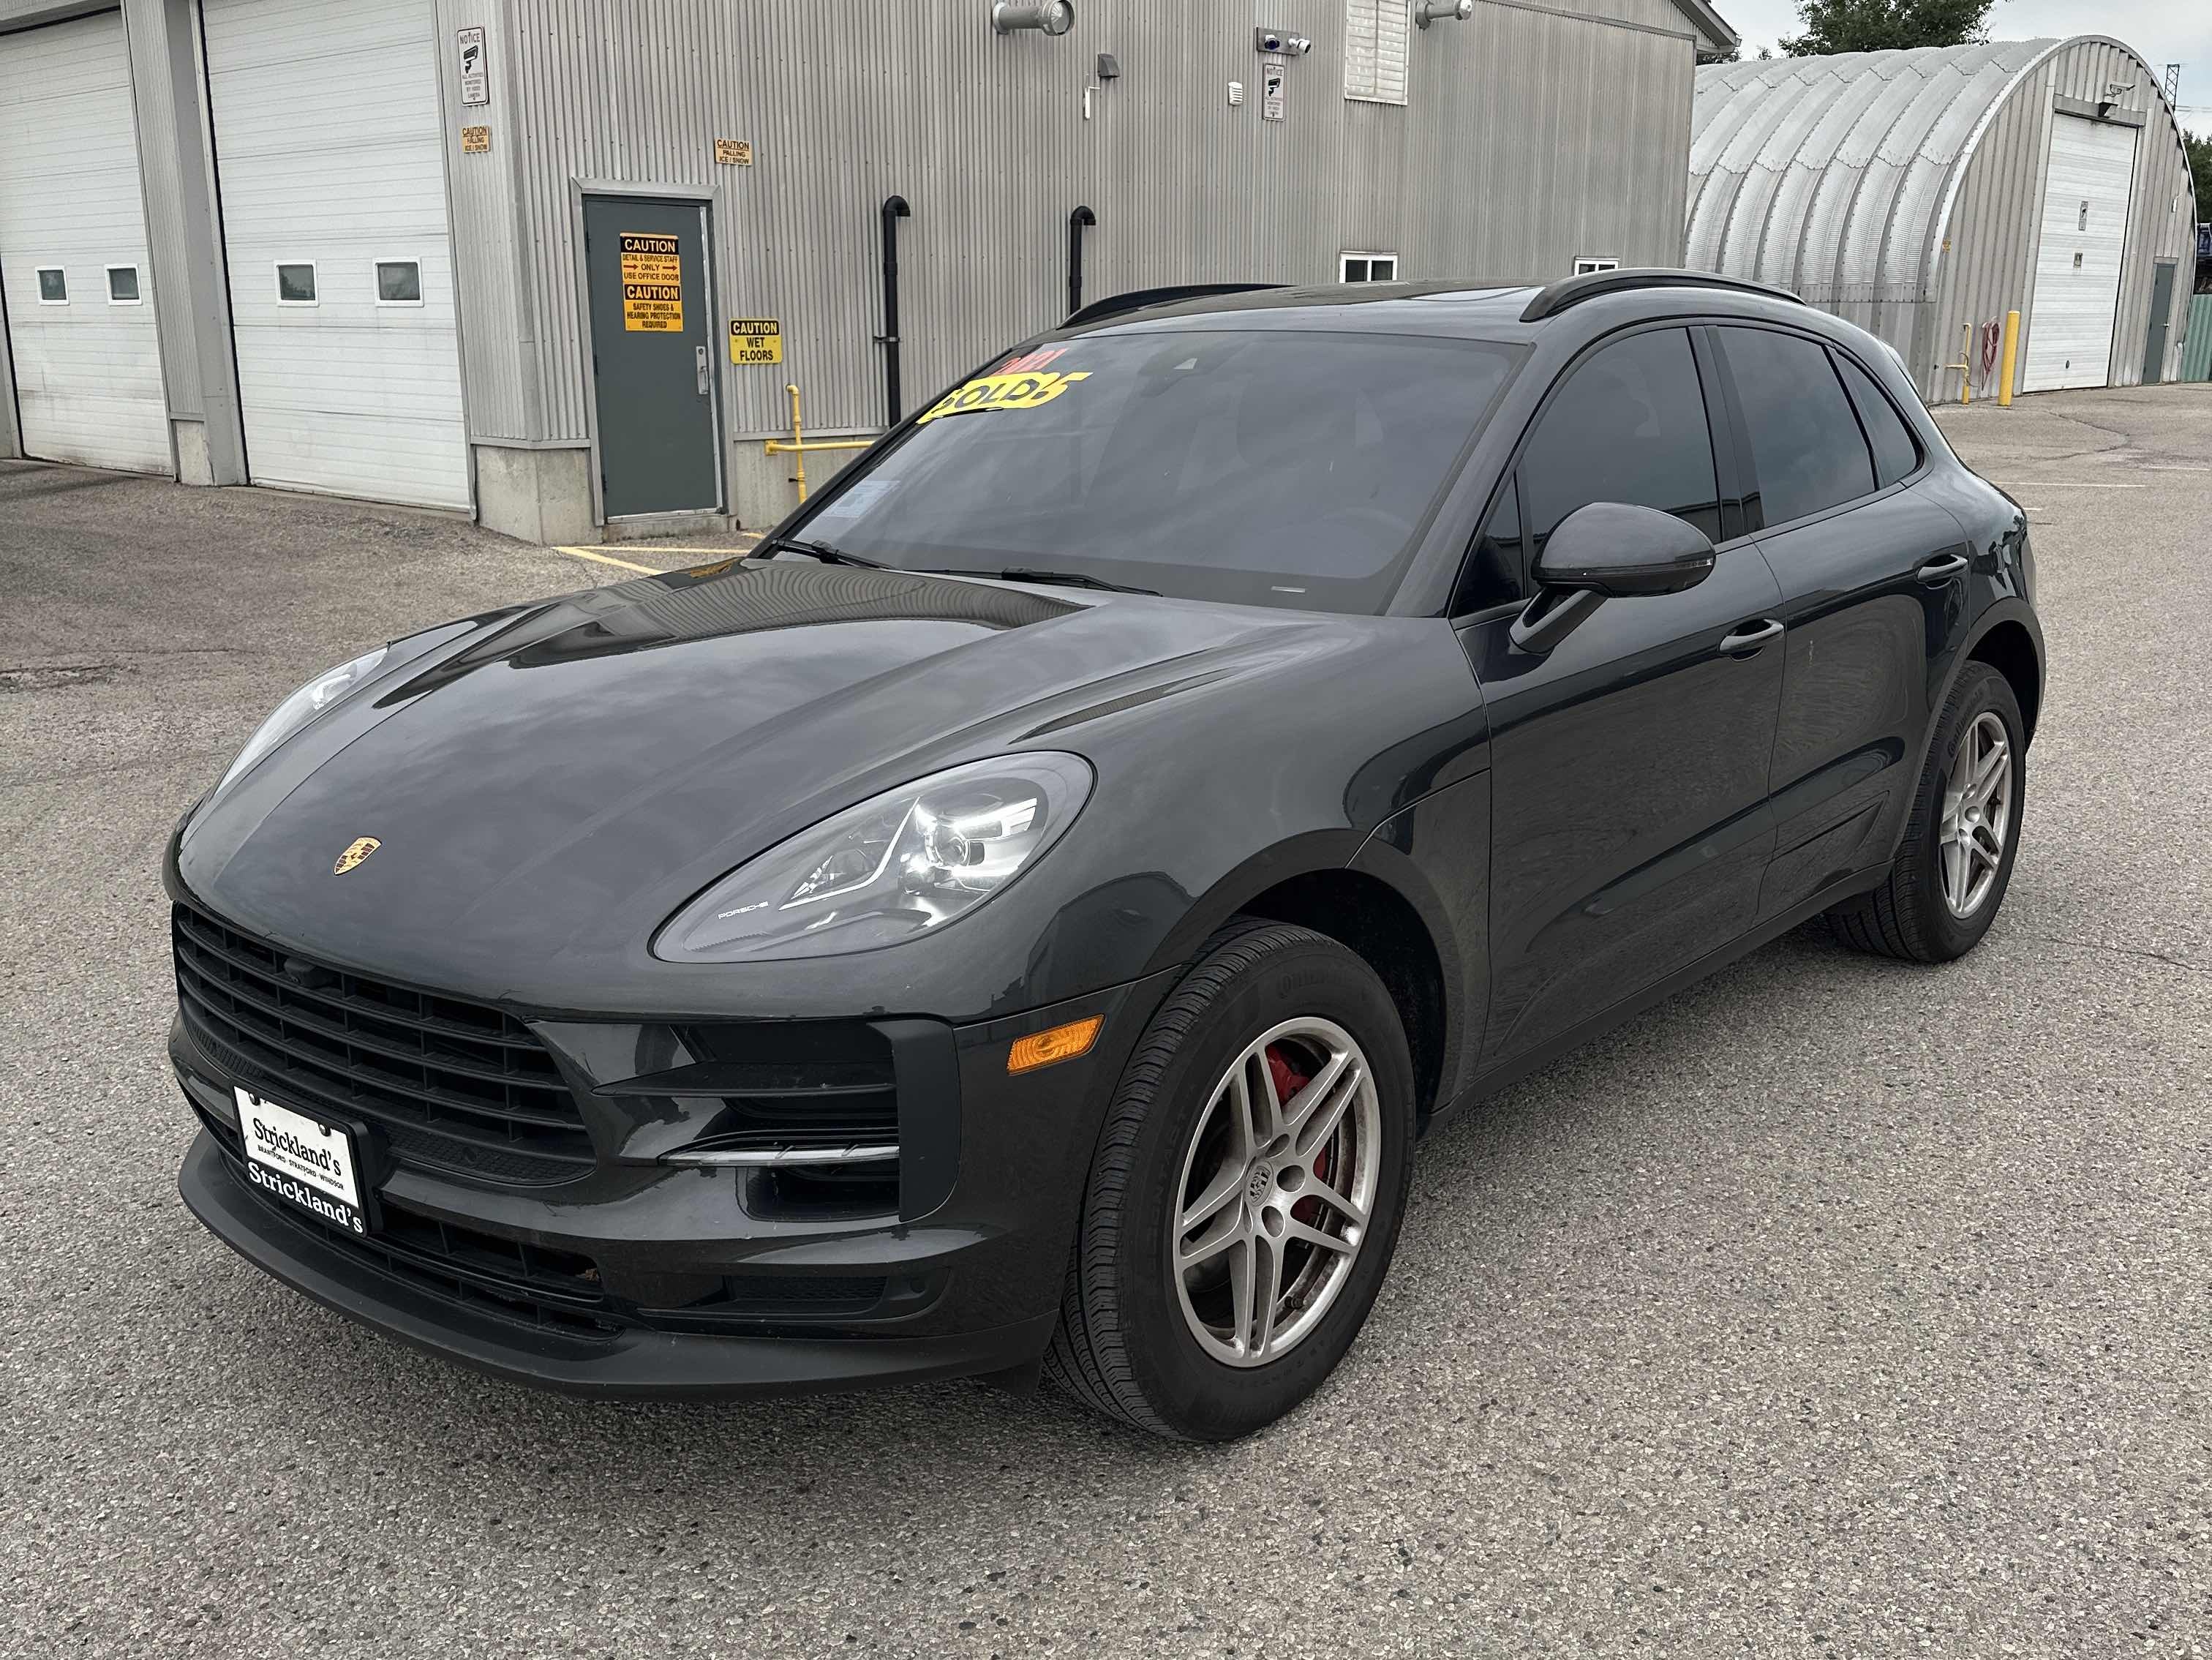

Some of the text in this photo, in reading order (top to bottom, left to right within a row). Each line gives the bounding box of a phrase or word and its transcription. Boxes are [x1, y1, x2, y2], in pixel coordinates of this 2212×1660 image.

[459, 33, 480, 44] NOTICE
[462, 126, 486, 135] CAUTION
[717, 139, 749, 150] CAUTION
[625, 239, 676, 252] CAUTION
[622, 254, 639, 262] DETAIL
[644, 255, 663, 263] SERVICE
[627, 285, 679, 300] CAUTION
[633, 303, 652, 311] SAFETY
[652, 303, 669, 311] SHOES
[627, 311, 649, 319] HEARING
[733, 322, 777, 334] CAUTION
[746, 337, 764, 348] WET
[740, 350, 773, 361] FLOORS
[930, 378, 1040, 414] SOLD
[718, 901, 769, 920] PORSCHE
[253, 1117, 342, 1176] Strickland's
[288, 1158, 317, 1178] STRATFORD
[248, 1161, 364, 1234] Strickland's
